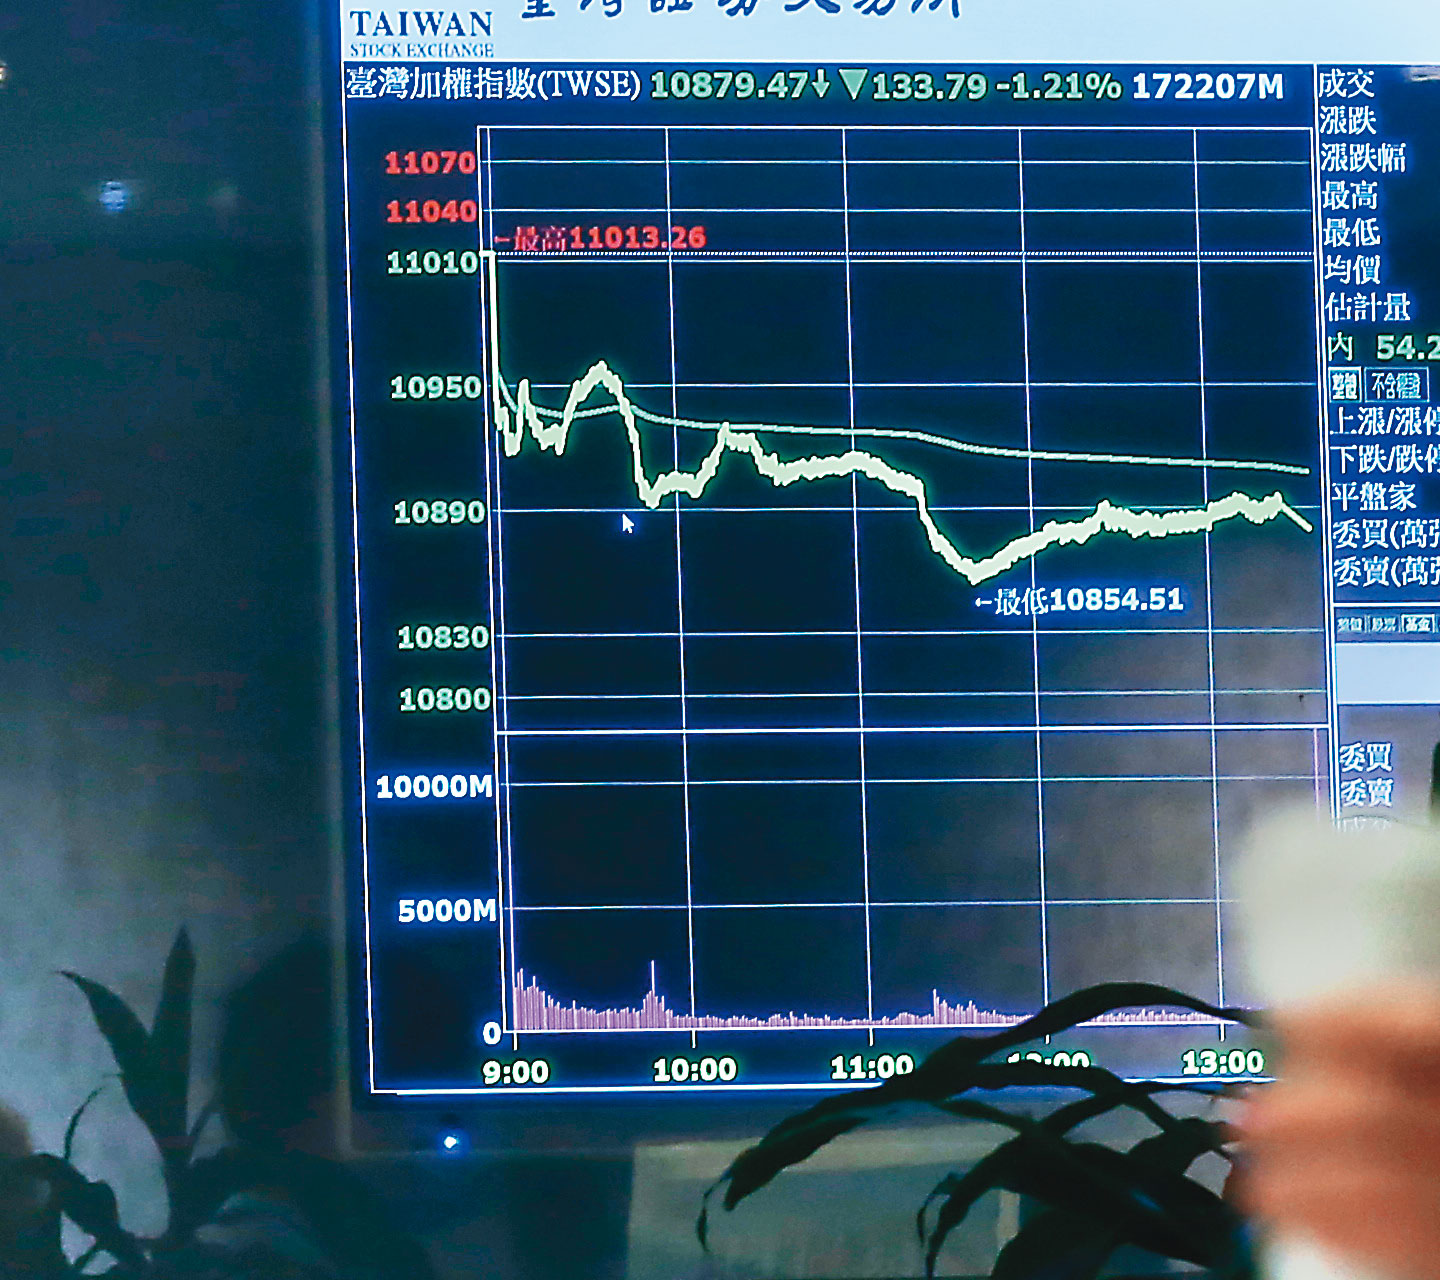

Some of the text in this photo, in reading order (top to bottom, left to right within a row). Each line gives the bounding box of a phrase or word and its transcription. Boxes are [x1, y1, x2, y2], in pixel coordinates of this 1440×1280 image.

[350, 11, 492, 36] TAIWAN
[350, 43, 494, 58] STOCK EXCHANGE
[346, 67, 1283, 101] 臺灣加權指數(TWSE) 10879.47 133.79 -1.21% 172207M
[1319, 69, 1374, 99] 成交
[1320, 106, 1376, 135] 漲跌
[384, 151, 476, 175] 11070
[1320, 143, 1406, 173] 漲跌幅
[1322, 181, 1378, 210] 最高
[386, 200, 478, 224] 11040
[1323, 218, 1381, 247] 最低
[387, 251, 479, 275] 11010
[1324, 256, 1381, 285] 均價
[1325, 293, 1411, 322] 估計量
[1327, 332, 1353, 361] 內
[390, 375, 482, 400] 10950
[1331, 481, 1418, 512] 平盤家
[394, 500, 486, 525] 10890
[398, 625, 490, 650] 10830
[399, 687, 491, 712] 10800
[1339, 742, 1393, 773] 委買
[376, 774, 493, 799] 10000M
[1340, 777, 1394, 808] 委賣
[398, 898, 496, 923] 5000M
[482, 1022, 501, 1045] 0
[482, 1060, 550, 1085] 9:00
[653, 1057, 737, 1081] 10:00
[831, 1054, 914, 1081] 11:00
[1183, 1050, 1263, 1075] 13:00
